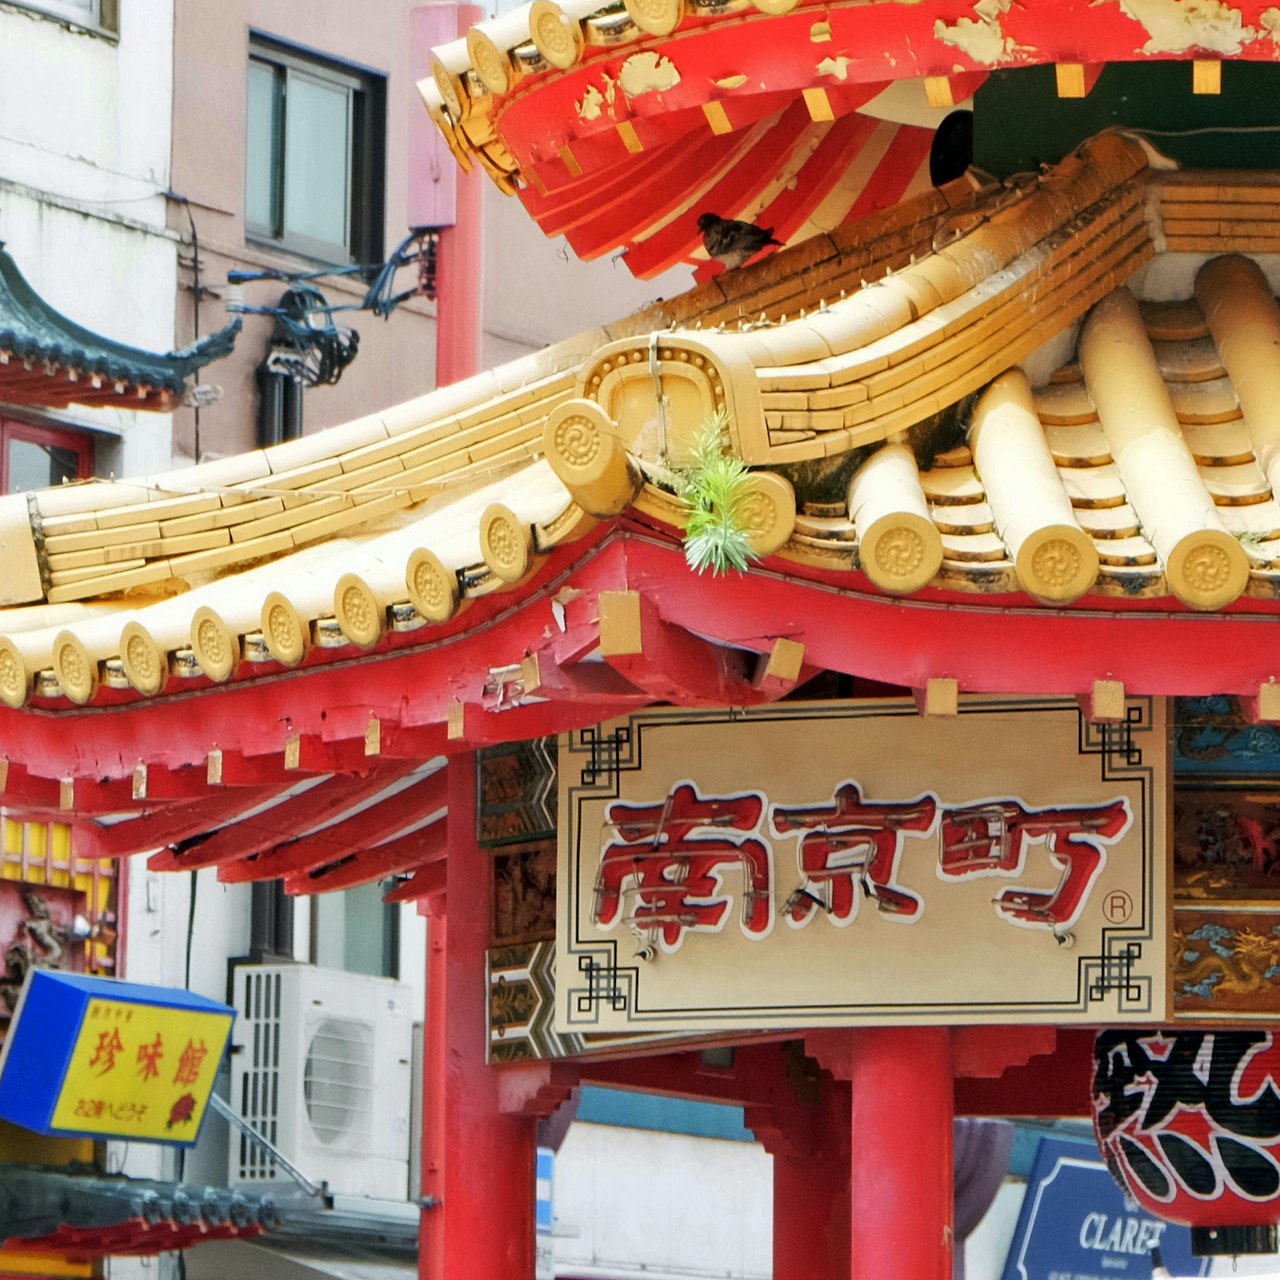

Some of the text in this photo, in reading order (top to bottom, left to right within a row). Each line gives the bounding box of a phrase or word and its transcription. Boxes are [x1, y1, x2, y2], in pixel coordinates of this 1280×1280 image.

[589, 778, 1132, 955] 南京町
[89, 1027, 208, 1087] 珍味館
